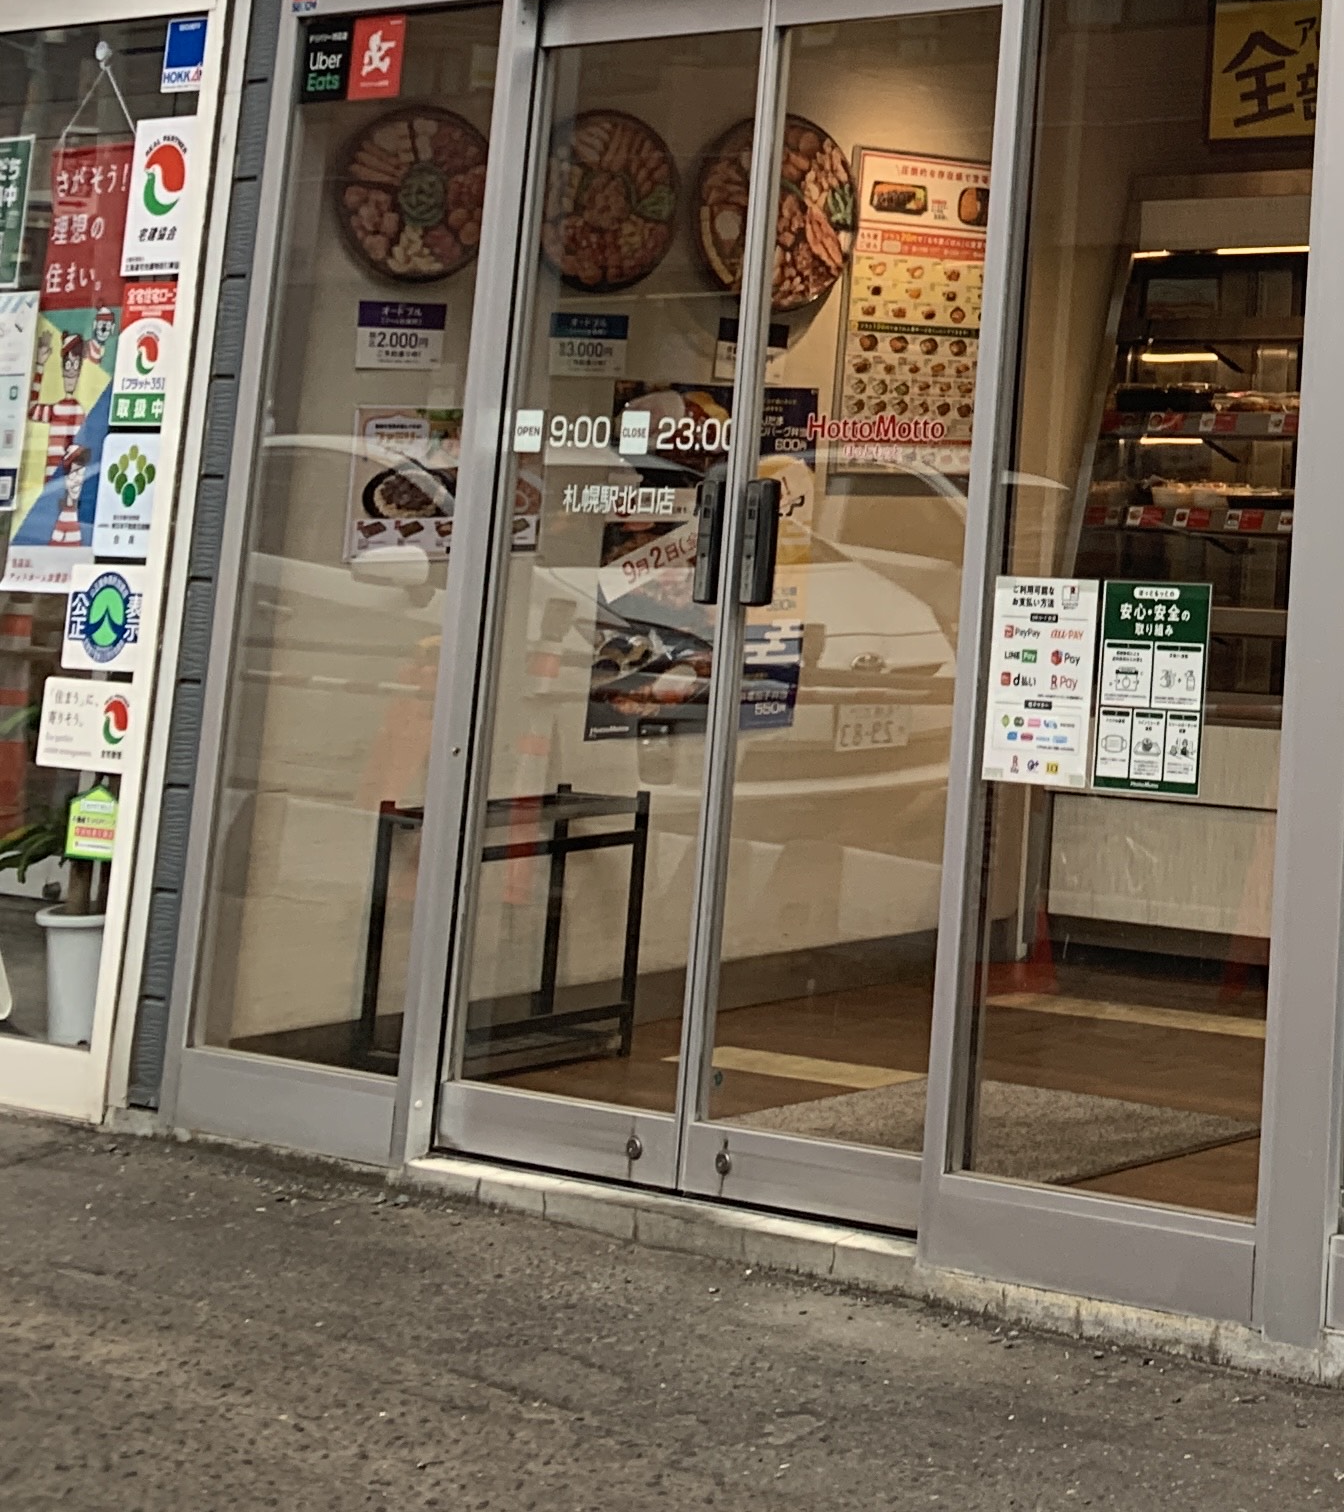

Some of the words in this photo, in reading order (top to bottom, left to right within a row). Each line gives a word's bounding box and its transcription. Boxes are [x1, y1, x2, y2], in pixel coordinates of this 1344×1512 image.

[310, 52, 342, 71] Uber
[306, 73, 340, 91] Eats
[56, 163, 130, 197] さがそう!
[52, 214, 105, 245] 理想の
[46, 262, 103, 294] 住まい。
[517, 426, 541, 437] OPEN
[549, 415, 611, 449] 9:00
[623, 426, 647, 438] CLOSE
[562, 484, 676, 515] 札幌駅北口店
[68, 593, 90, 639] 公正
[1120, 602, 1191, 622] 安心・安全の
[1015, 627, 1041, 639] PayPay
[1068, 629, 1085, 641] PAY
[1135, 622, 1174, 637] 取り組み
[1064, 652, 1081, 666] Pay
